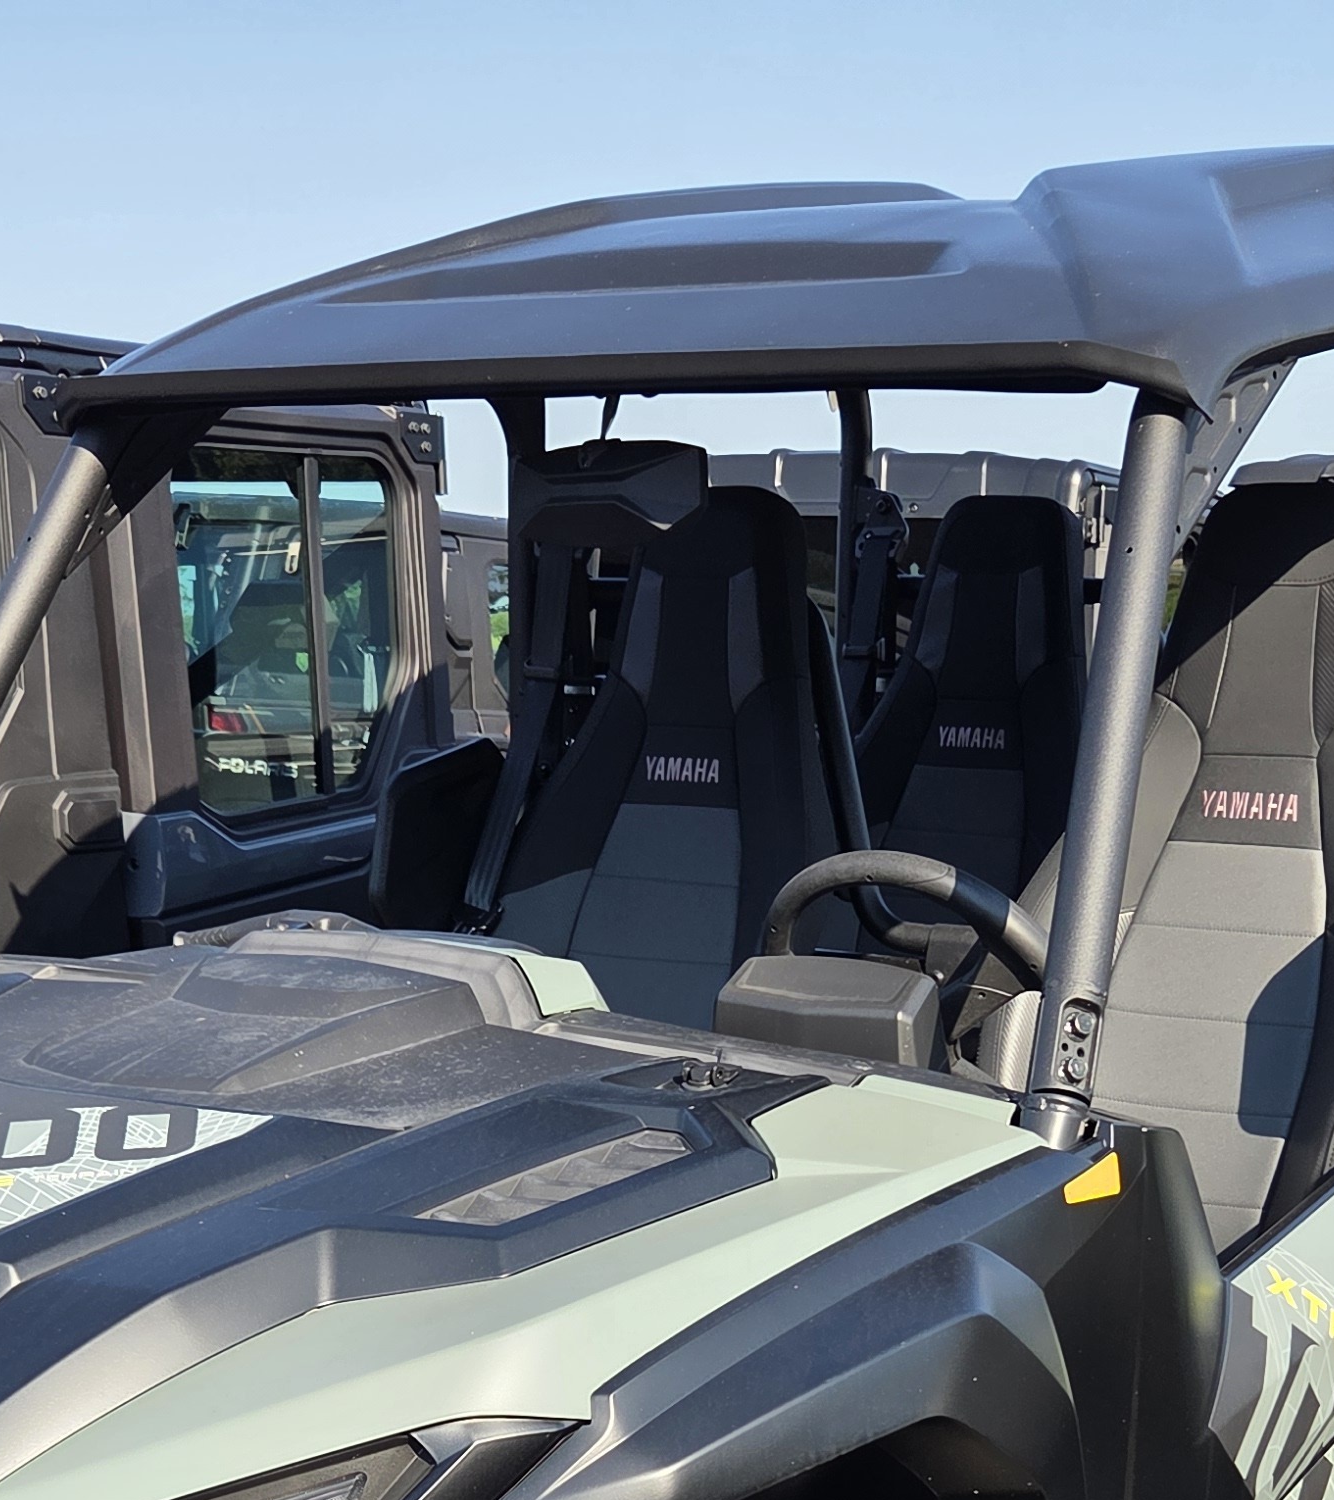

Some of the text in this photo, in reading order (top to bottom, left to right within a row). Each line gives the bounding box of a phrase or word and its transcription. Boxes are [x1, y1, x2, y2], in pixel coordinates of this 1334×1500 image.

[939, 726, 1006, 750] YAMAHA
[646, 756, 720, 783] YAMAHA
[1203, 790, 1299, 822] YAMAHA
